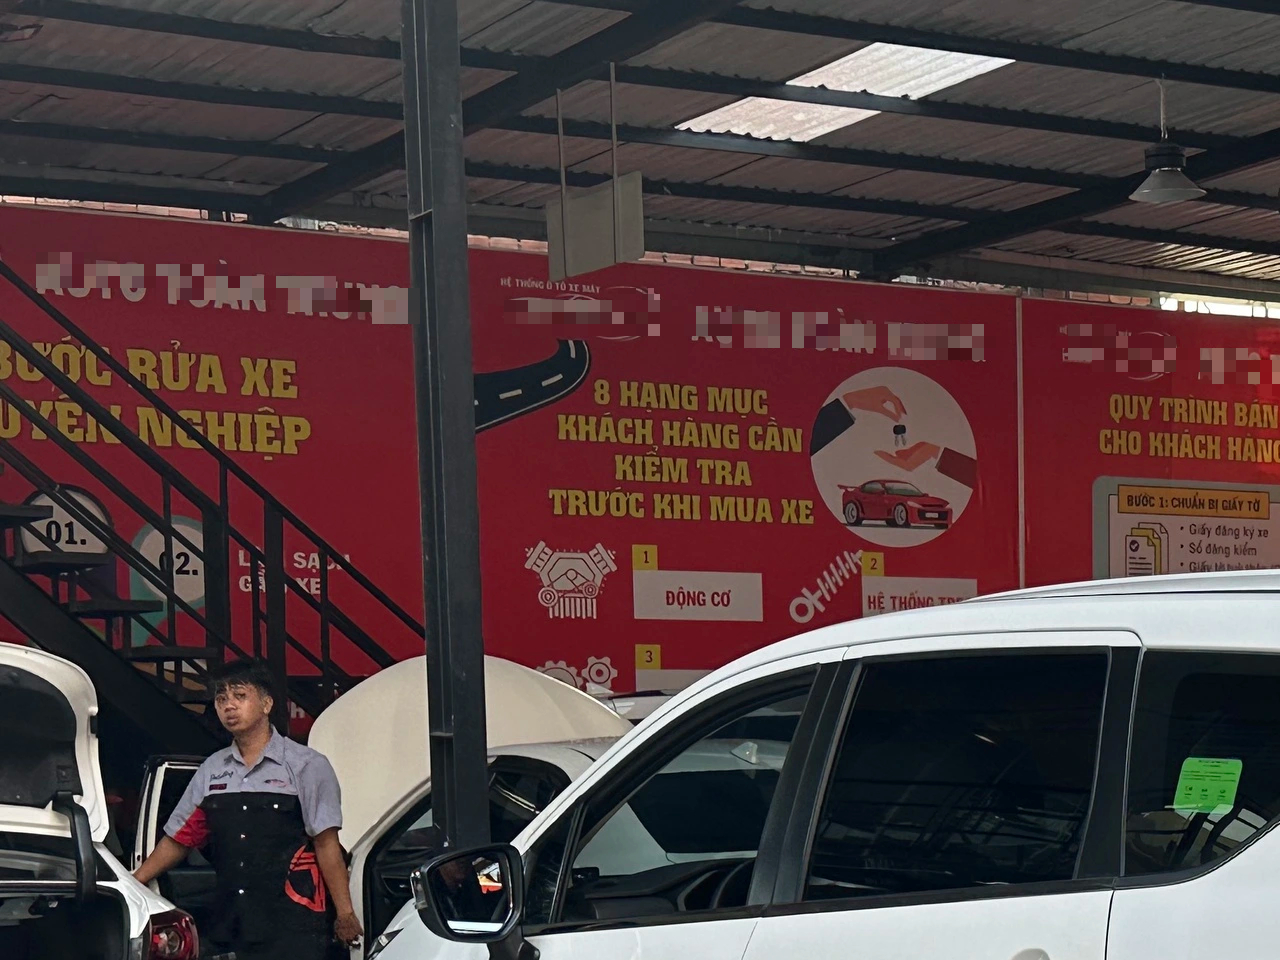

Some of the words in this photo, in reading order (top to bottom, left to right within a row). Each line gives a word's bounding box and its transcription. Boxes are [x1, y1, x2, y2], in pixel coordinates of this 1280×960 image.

[126, 340, 228, 394] RỬA
[240, 356, 299, 399] XE
[593, 379, 611, 405] 8
[619, 380, 699, 413] HẠNG
[707, 386, 769, 418] MỤC
[1109, 394, 1153, 423] QUY
[1159, 394, 1228, 425] TRÌNH
[1233, 399, 1279, 429] BÁN
[136, 406, 311, 461] NGHIỆP
[557, 412, 654, 445] KHÁCH
[662, 416, 740, 449] HÀNG
[748, 417, 803, 453] CẦN
[1099, 429, 1142, 455] CHO
[1148, 429, 1221, 460] KHÁCH
[615, 445, 689, 483] KIỂM
[697, 458, 752, 486] TRA
[549, 486, 645, 518] TRƯỚC
[653, 494, 702, 520] KHI
[710, 496, 773, 523] MUA
[781, 499, 815, 525] XE
[1127, 492, 1155, 508] BƯỚC
[1208, 498, 1218, 513] BỊ
[1222, 496, 1244, 511] GIẤY
[1258, 528, 1269, 538] xe
[643, 550, 650, 564] 1
[870, 557, 878, 570] 2
[665, 586, 707, 610] ĐỘNG
[710, 589, 732, 607] CƠ
[645, 650, 653, 663] 3
